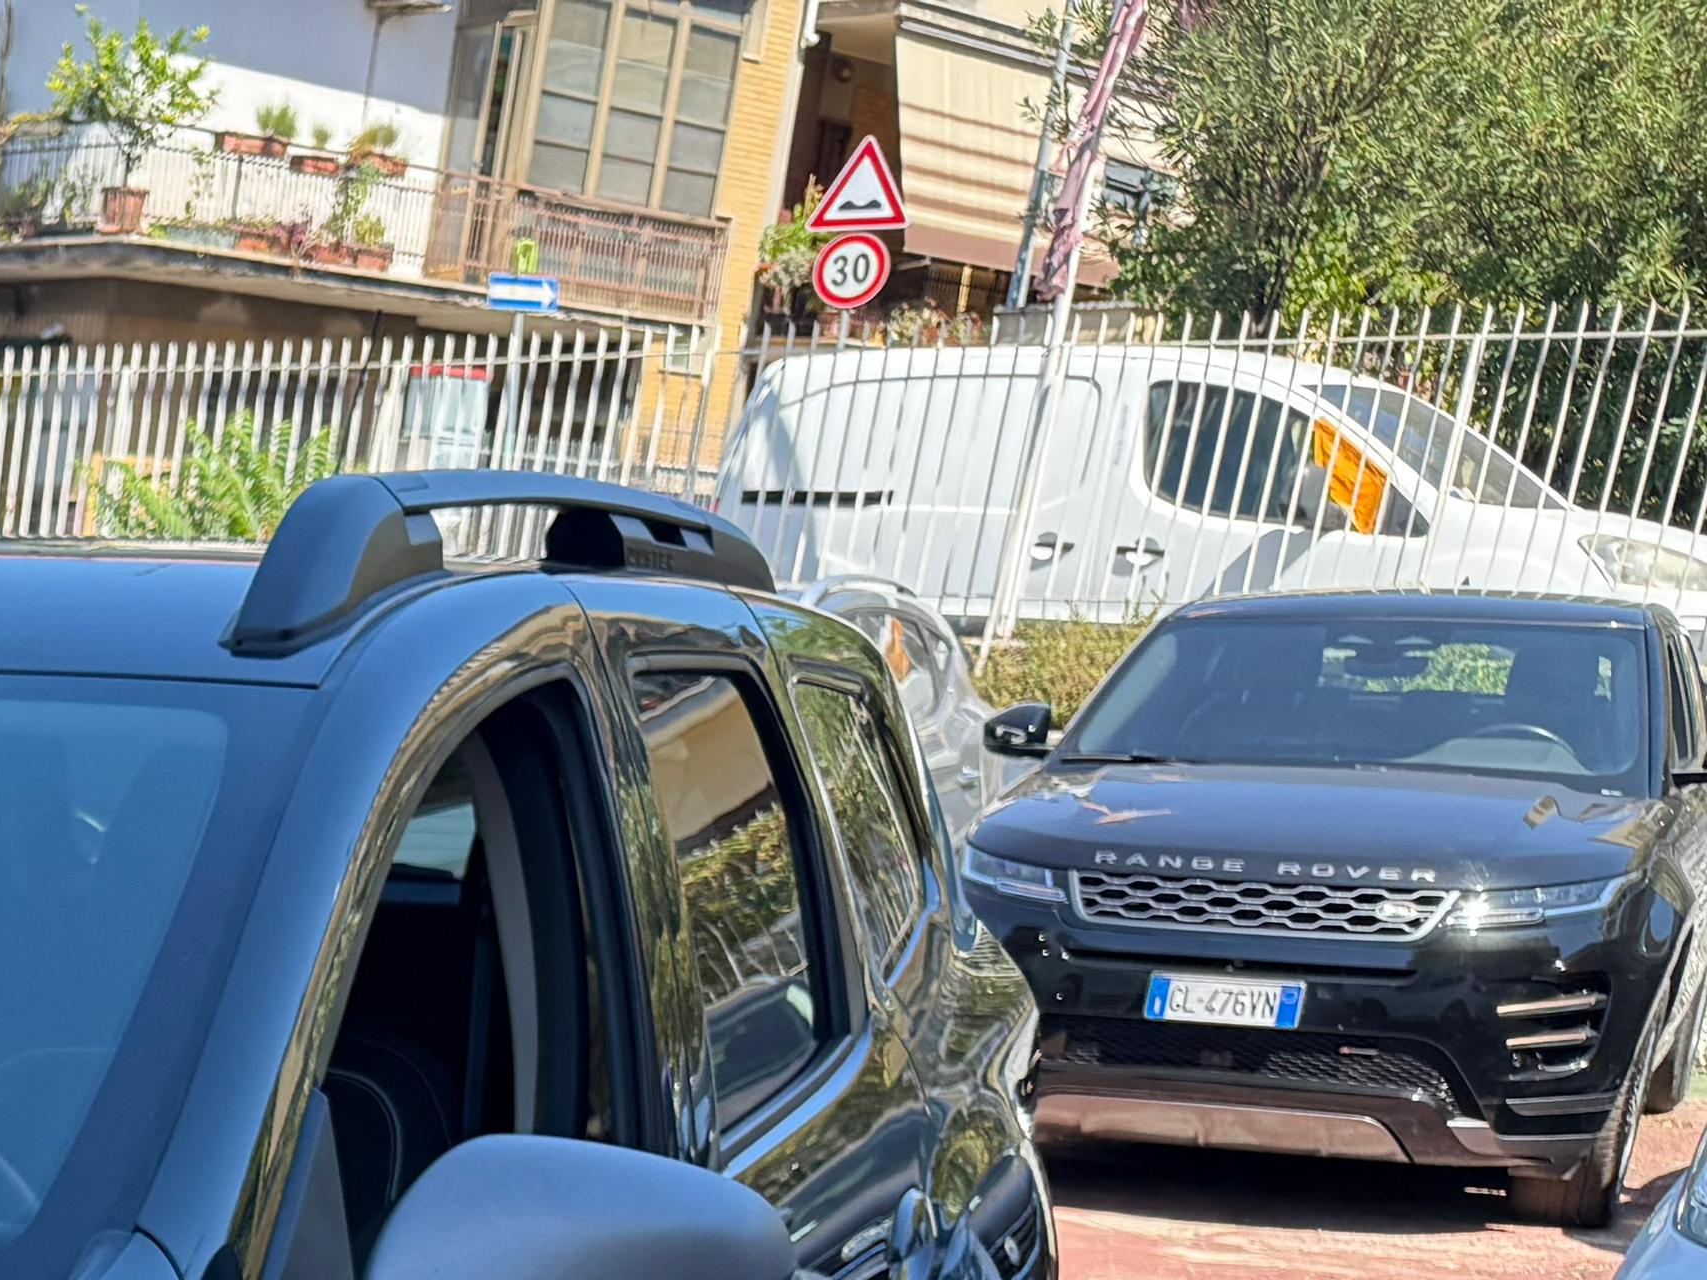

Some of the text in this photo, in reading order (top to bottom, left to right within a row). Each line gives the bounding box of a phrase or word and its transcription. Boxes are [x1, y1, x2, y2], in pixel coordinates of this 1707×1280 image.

[831, 253, 870, 286] 30
[1095, 849, 1437, 883] RANGE ROVER
